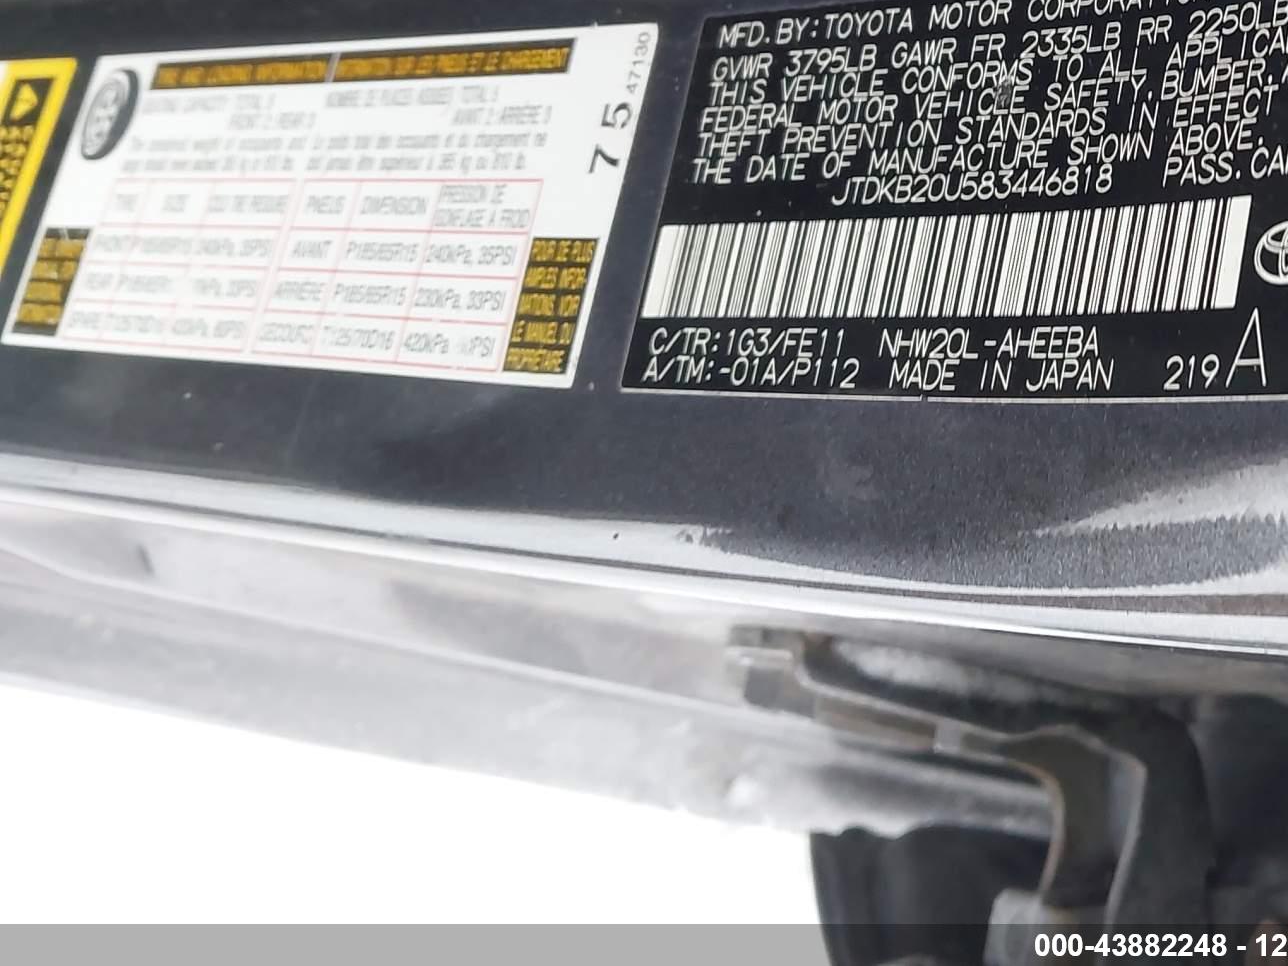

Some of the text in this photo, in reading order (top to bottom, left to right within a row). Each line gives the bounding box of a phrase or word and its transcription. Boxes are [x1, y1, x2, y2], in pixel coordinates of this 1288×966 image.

[627, 31, 652, 95] 47130
[709, 78, 768, 106] THIS
[781, 68, 889, 102] VEHICLE
[901, 58, 1034, 95] CONFORMS
[1053, 54, 1084, 83] TO
[1099, 46, 1148, 79] ALL
[712, 52, 774, 82] GVWR
[785, 44, 878, 77] 3795LB
[891, 37, 958, 68] GAWR
[970, 33, 1006, 61] FR
[1021, 21, 1122, 59] 2335LB
[1137, 15, 1173, 45] RR
[698, 129, 771, 158] THEFT
[782, 119, 943, 153] PREVENTION
[954, 107, 1108, 145] STANDARDS
[1129, 101, 1160, 131] IN
[1173, 84, 1280, 128] EFFECT
[699, 102, 802, 133] FEDERAL
[816, 94, 899, 125] MOTOR
[914, 85, 1030, 120] VEHICLE
[692, 117, 1264, 184] THE DATE OF MANUFACTURE SHOWN ABOVE.
[832, 164, 1113, 205] JTDKB20U583446818
[888, 358, 960, 391] MADE
[980, 359, 1013, 391] IN
[1026, 358, 1115, 392] JAPAN
[1163, 354, 1220, 391] 219
[1226, 307, 1268, 389] A
